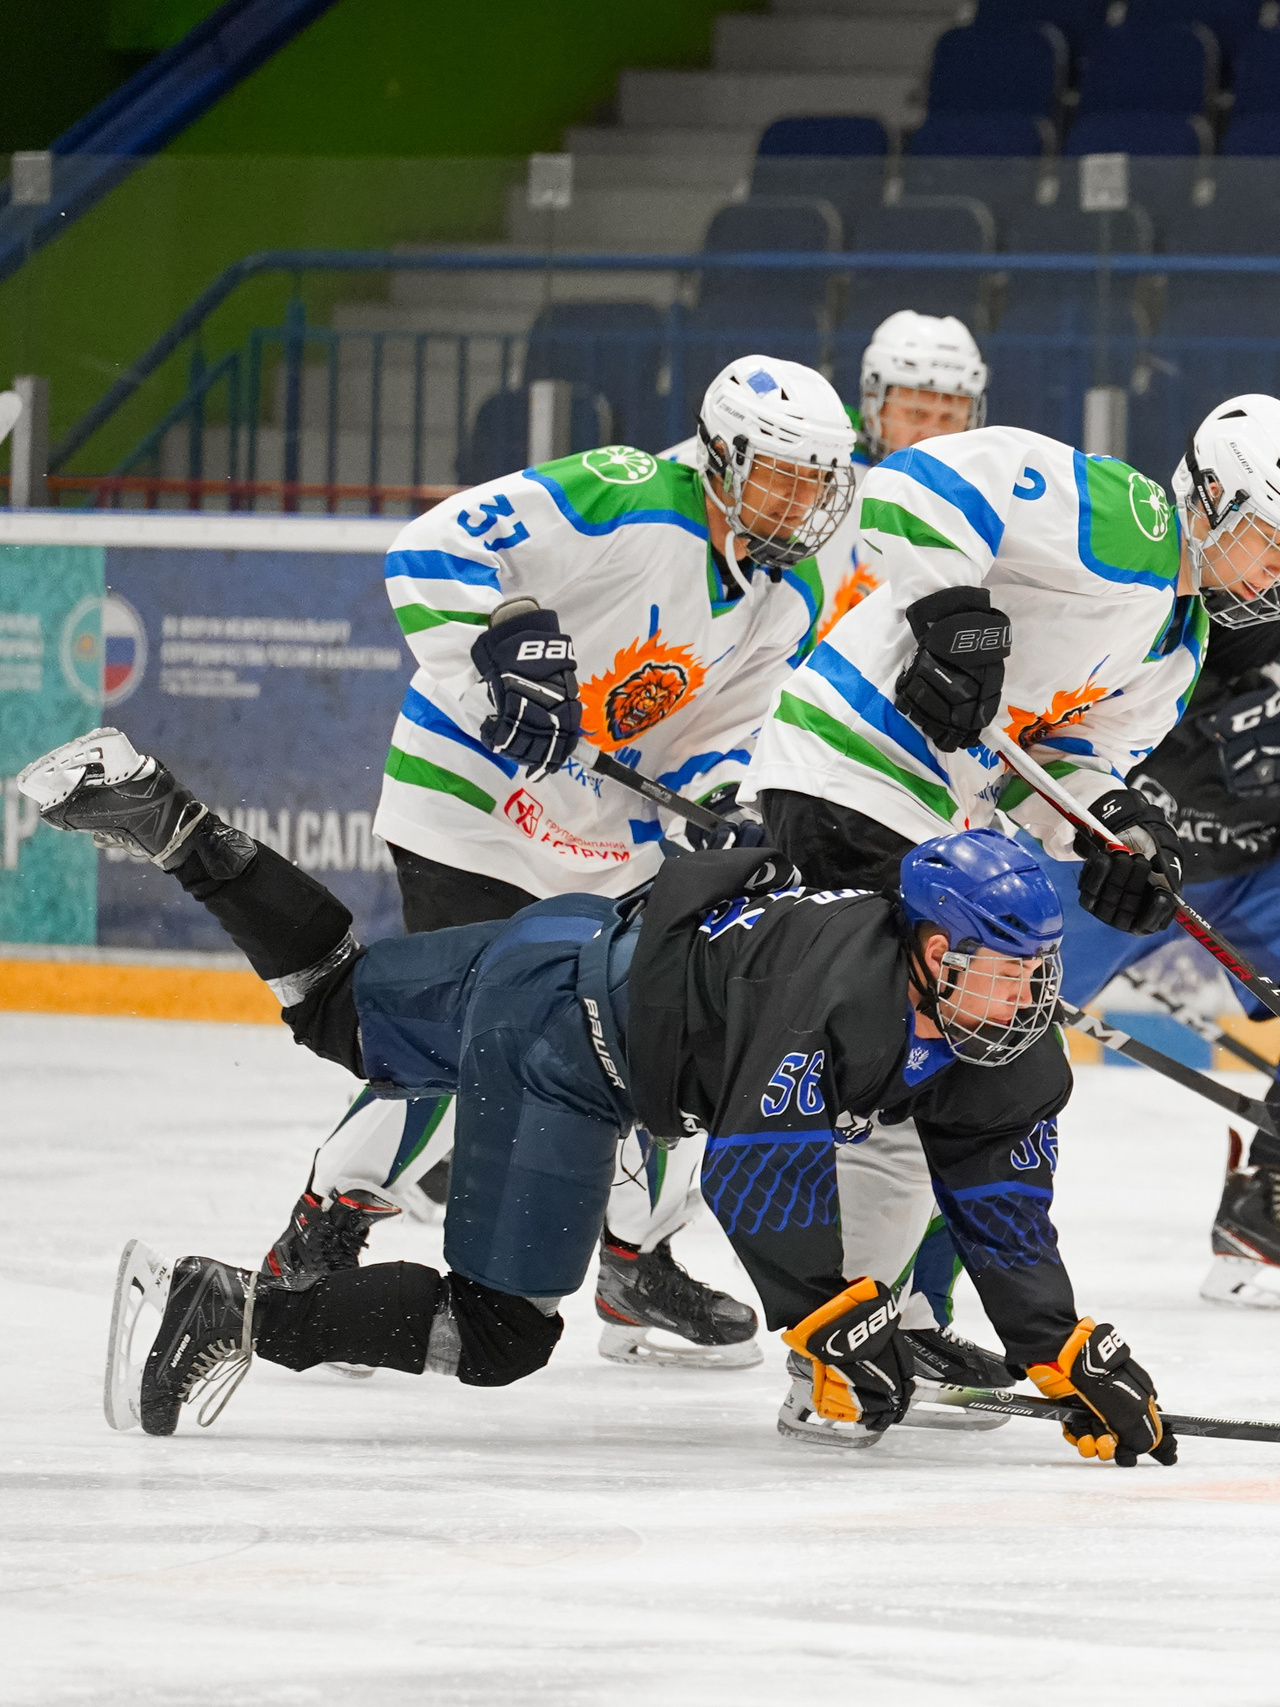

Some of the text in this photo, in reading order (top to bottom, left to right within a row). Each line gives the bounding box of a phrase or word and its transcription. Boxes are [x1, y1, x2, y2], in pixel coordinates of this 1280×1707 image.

[1229, 441, 1254, 475] BAUER
[457, 493, 531, 553] 31
[1196, 484, 1214, 516] BAUER
[1175, 909, 1252, 981] BAUER
[583, 998, 627, 1090] BAUER
[761, 1050, 826, 1118] 56
[968, 1401, 1035, 1417] WARRIOR
